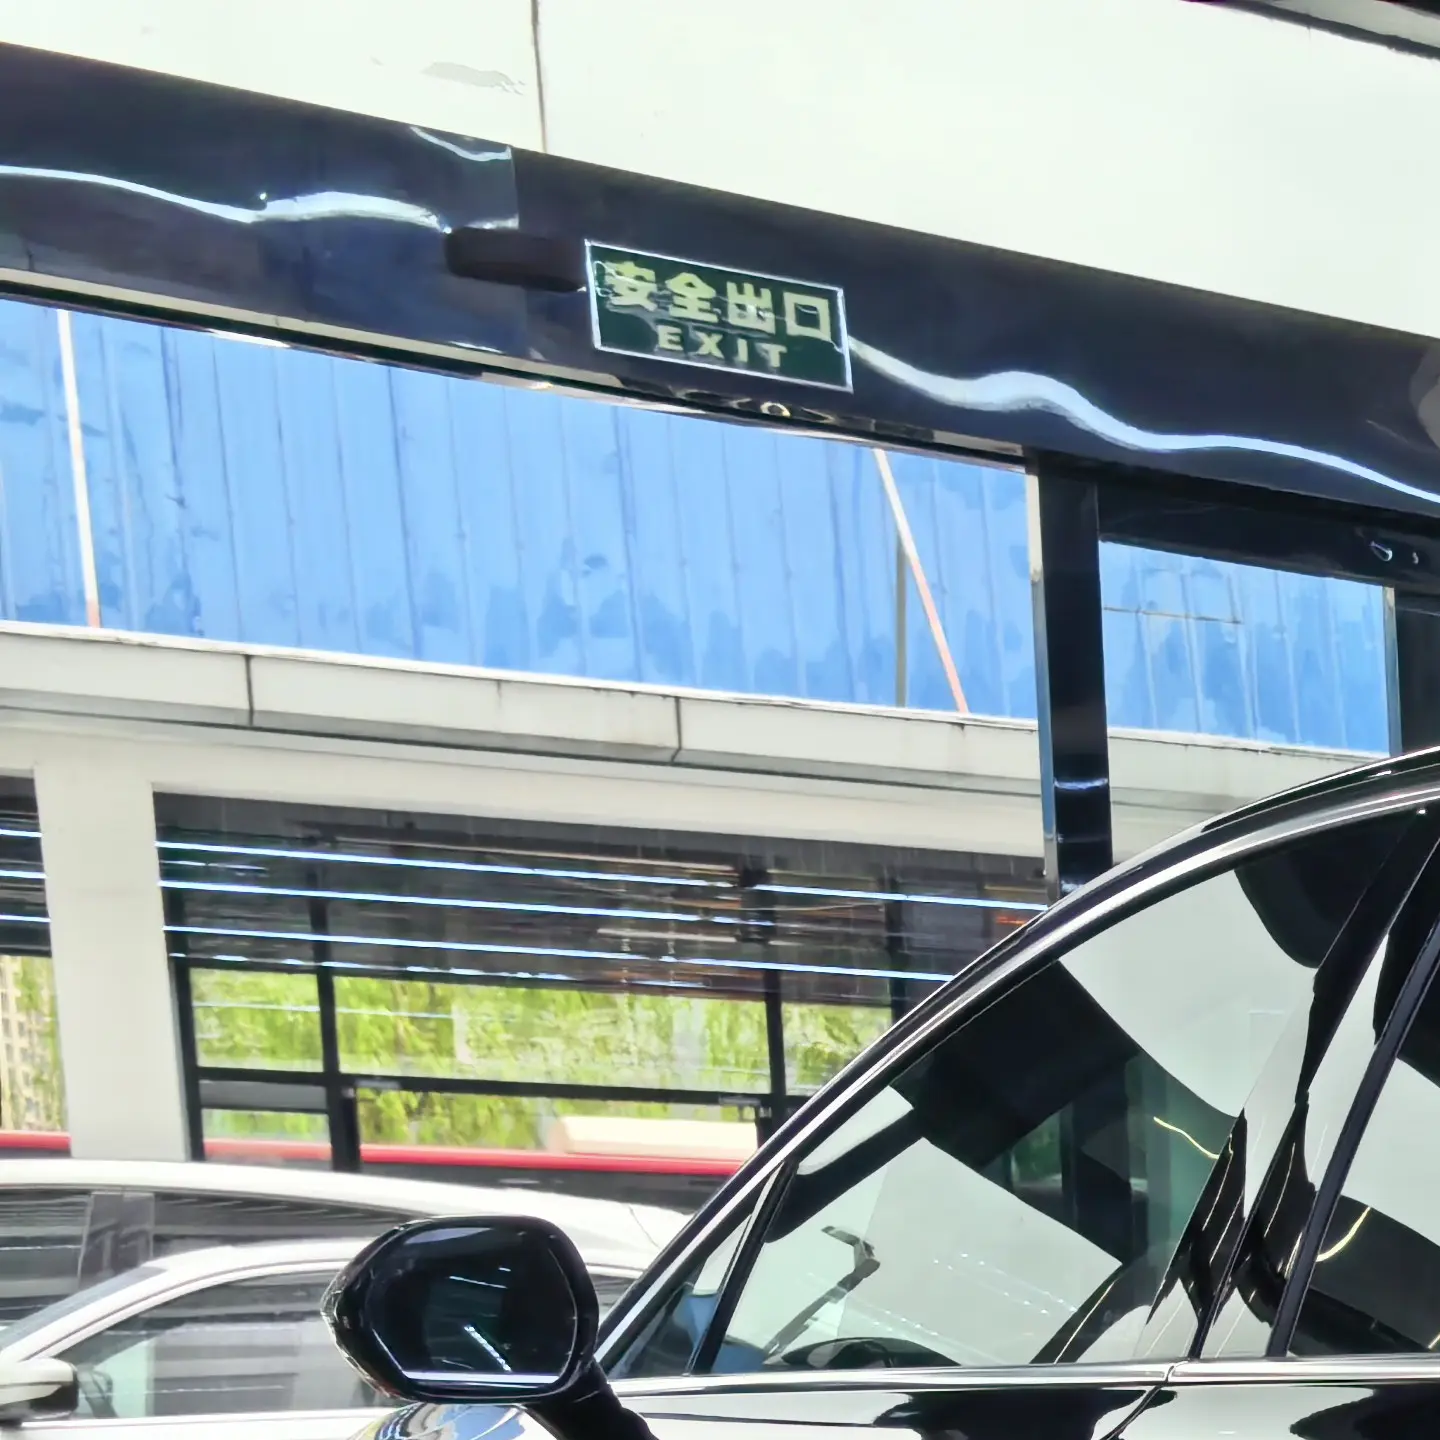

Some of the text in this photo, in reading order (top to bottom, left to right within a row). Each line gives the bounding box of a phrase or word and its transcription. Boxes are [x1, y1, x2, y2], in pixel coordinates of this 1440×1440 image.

[603, 260, 831, 342] 安全出口
[657, 325, 788, 368] EXIT
